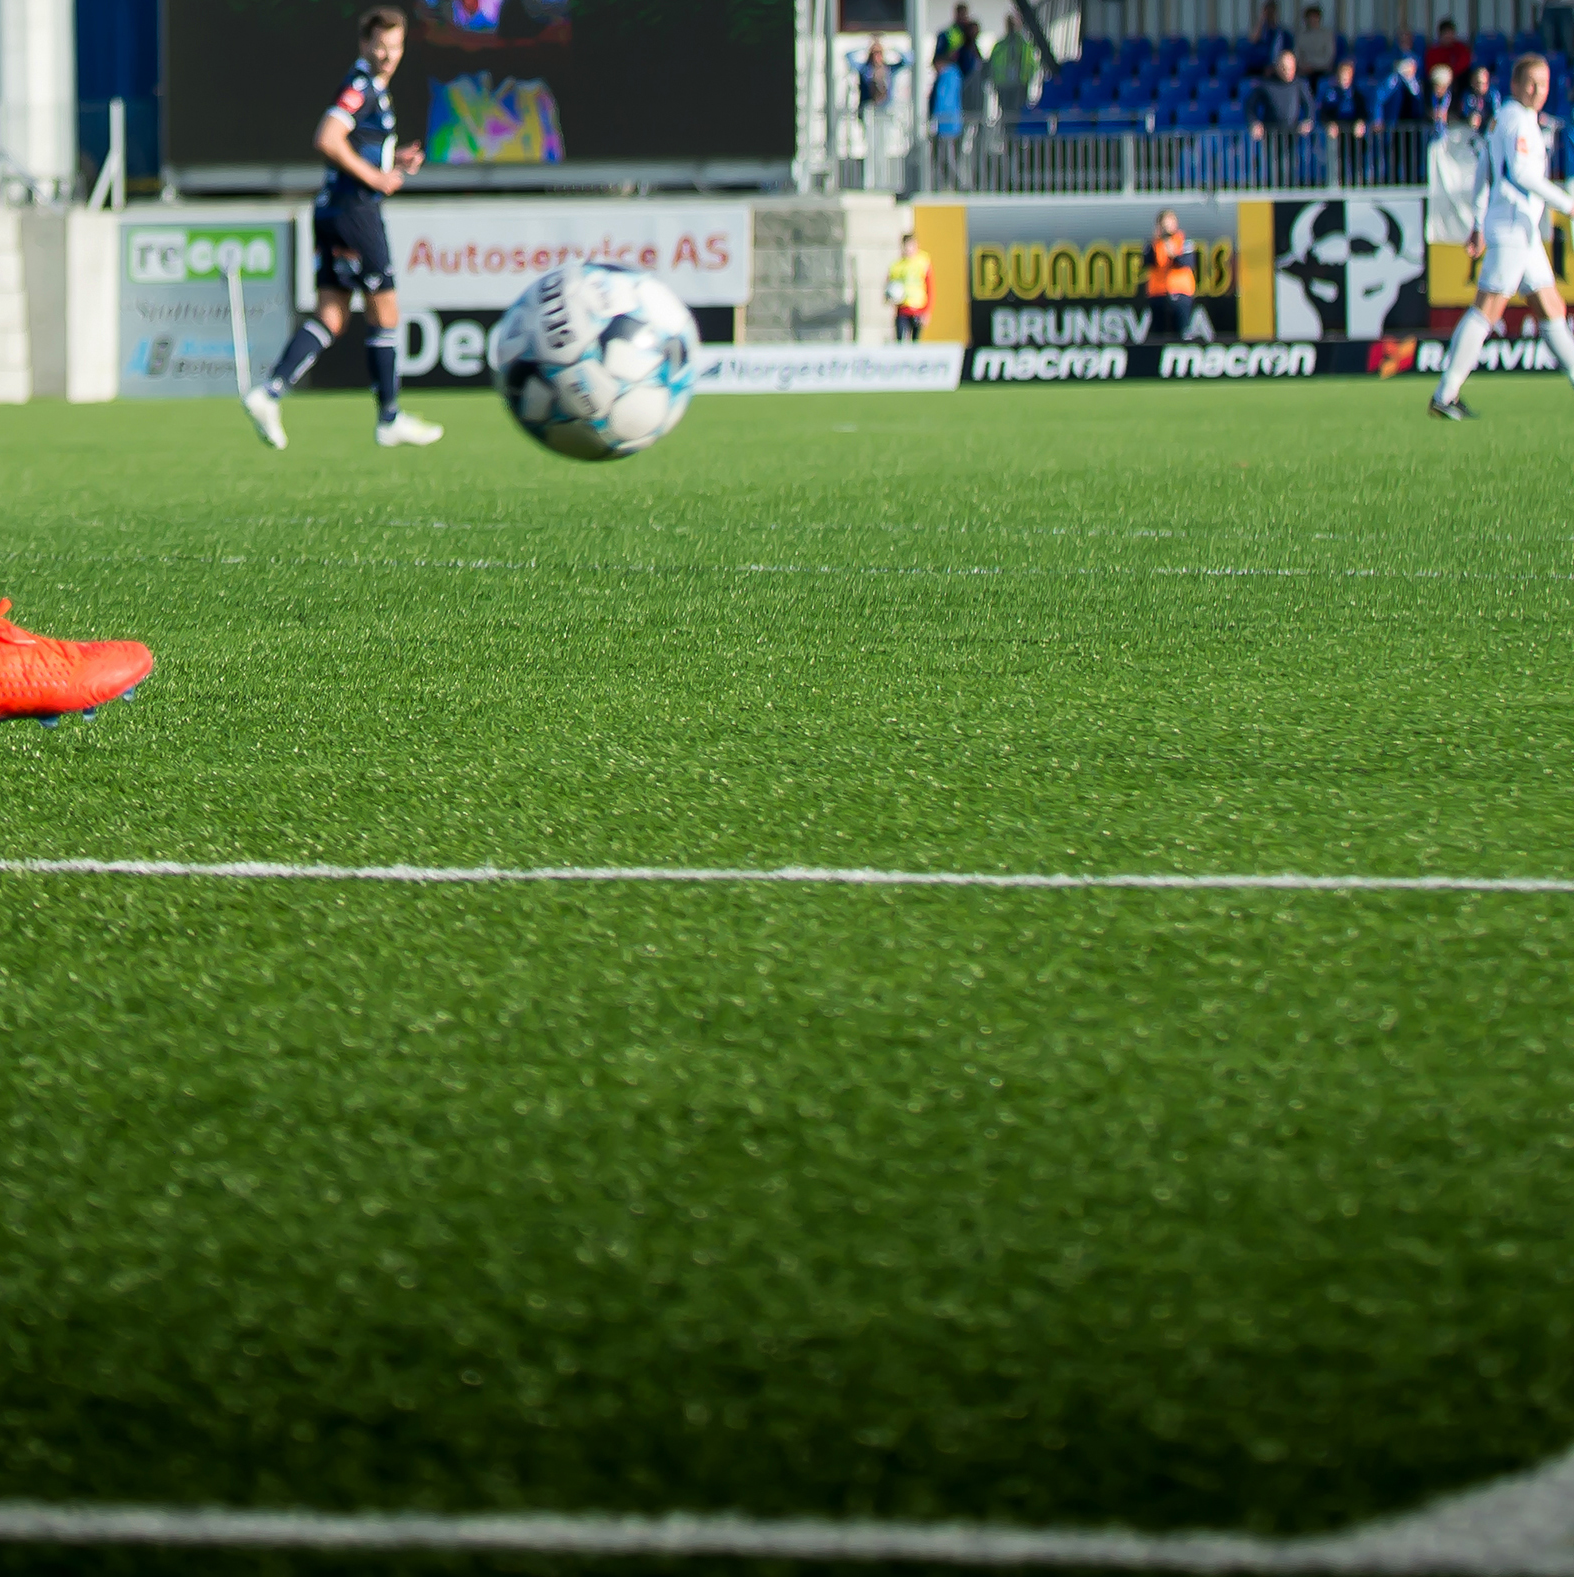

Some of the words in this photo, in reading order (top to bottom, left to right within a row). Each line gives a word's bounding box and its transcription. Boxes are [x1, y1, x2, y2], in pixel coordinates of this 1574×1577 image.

[408, 234, 659, 274] Autoservice
[672, 234, 730, 271] AS
[973, 239, 1233, 301] BUNNPIS
[990, 304, 1215, 346] BRUNSVA
[972, 345, 1127, 381] macron
[1159, 341, 1317, 378] macron
[1416, 337, 1558, 373] RMVIK
